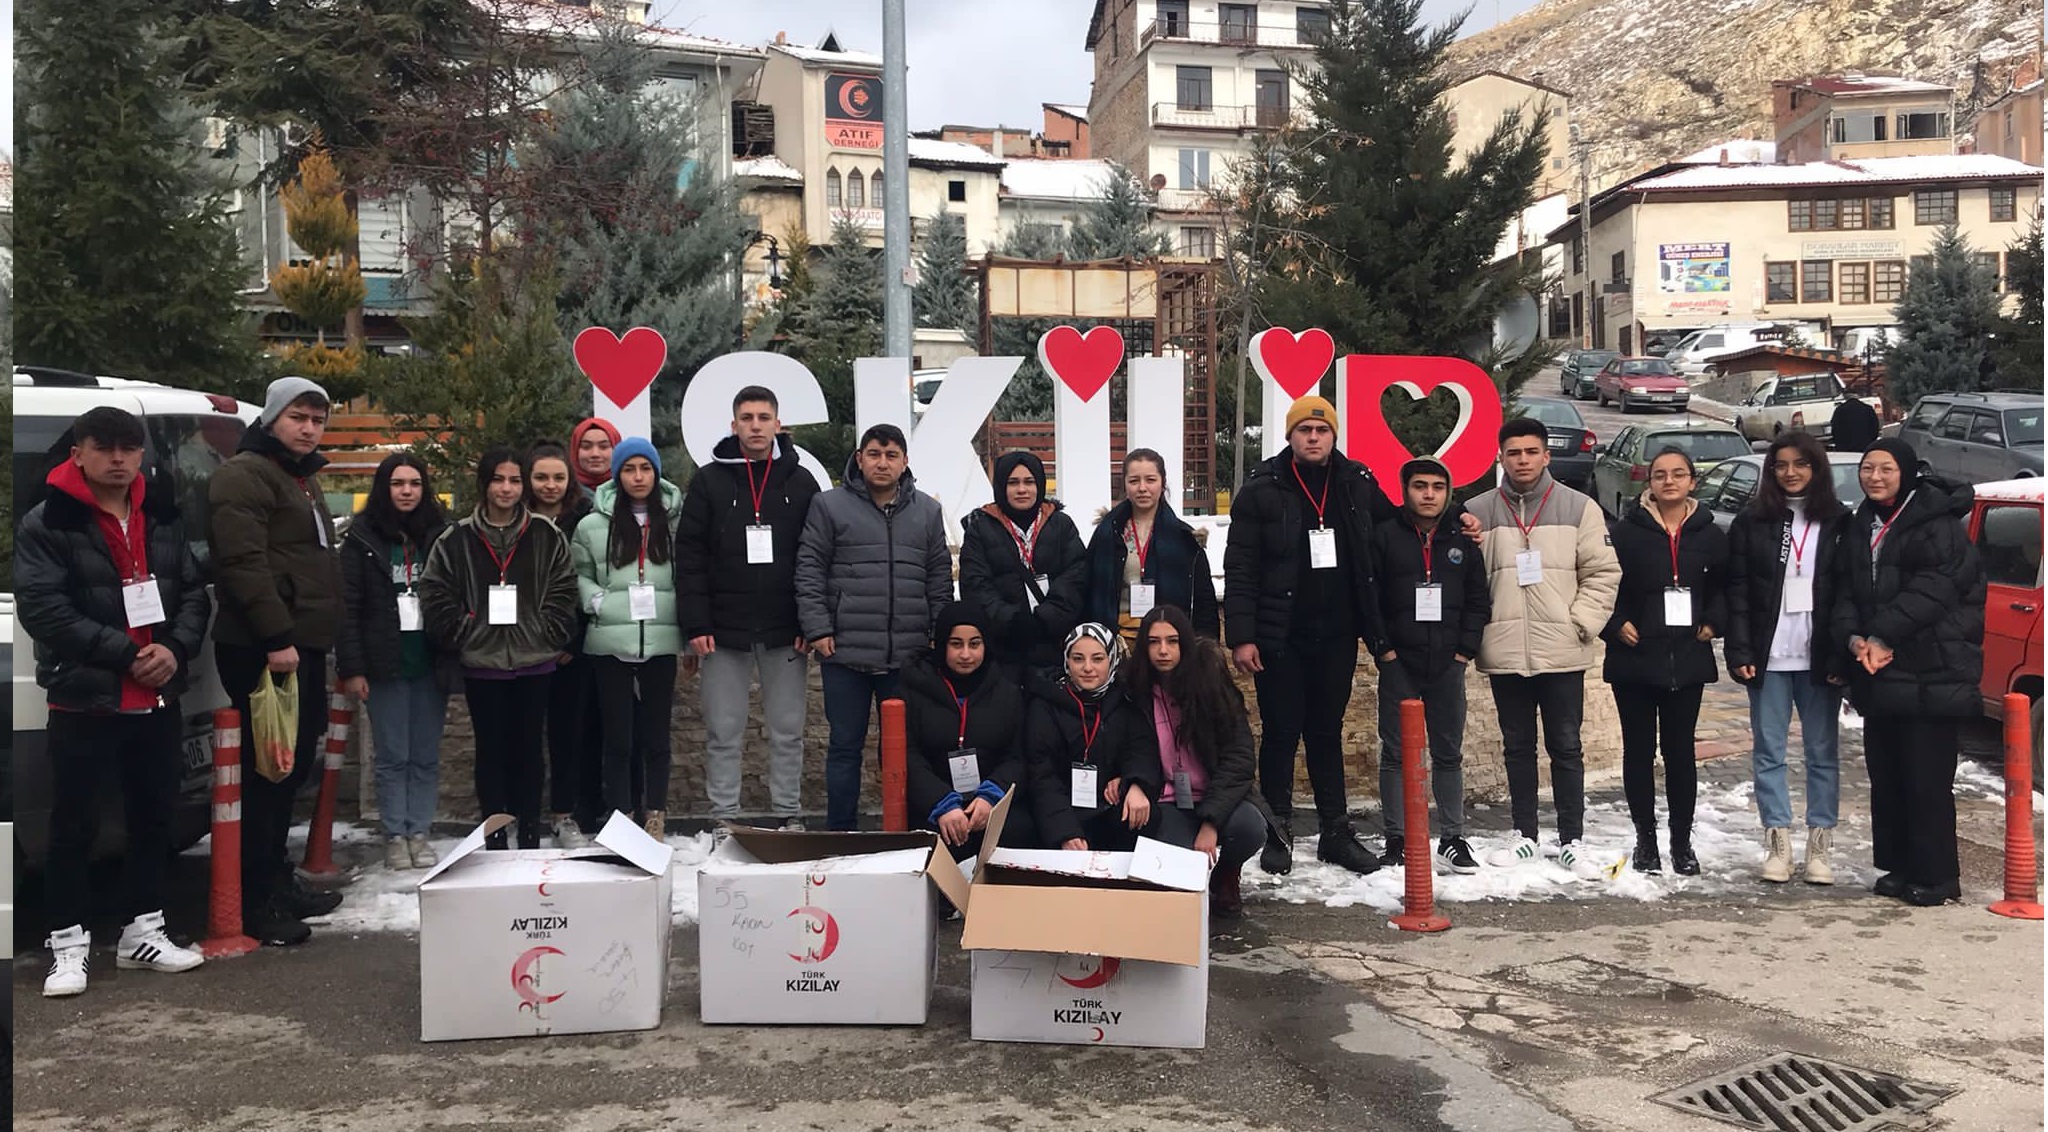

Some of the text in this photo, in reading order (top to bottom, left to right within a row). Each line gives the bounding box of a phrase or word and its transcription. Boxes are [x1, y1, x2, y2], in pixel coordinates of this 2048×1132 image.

[838, 129, 874, 139] ATIF
[1663, 243, 1726, 253] MERT
[1782, 533, 1791, 545] DO
[1780, 546, 1789, 564] JUST
[510, 916, 568, 931] KIZILAY
[526, 931, 551, 940] TÜRK
[801, 969, 826, 979] TÜRK
[786, 979, 840, 992] KIZILAY
[1072, 998, 1103, 1009] TÜRK
[1054, 1009, 1122, 1025] KIZILAY
